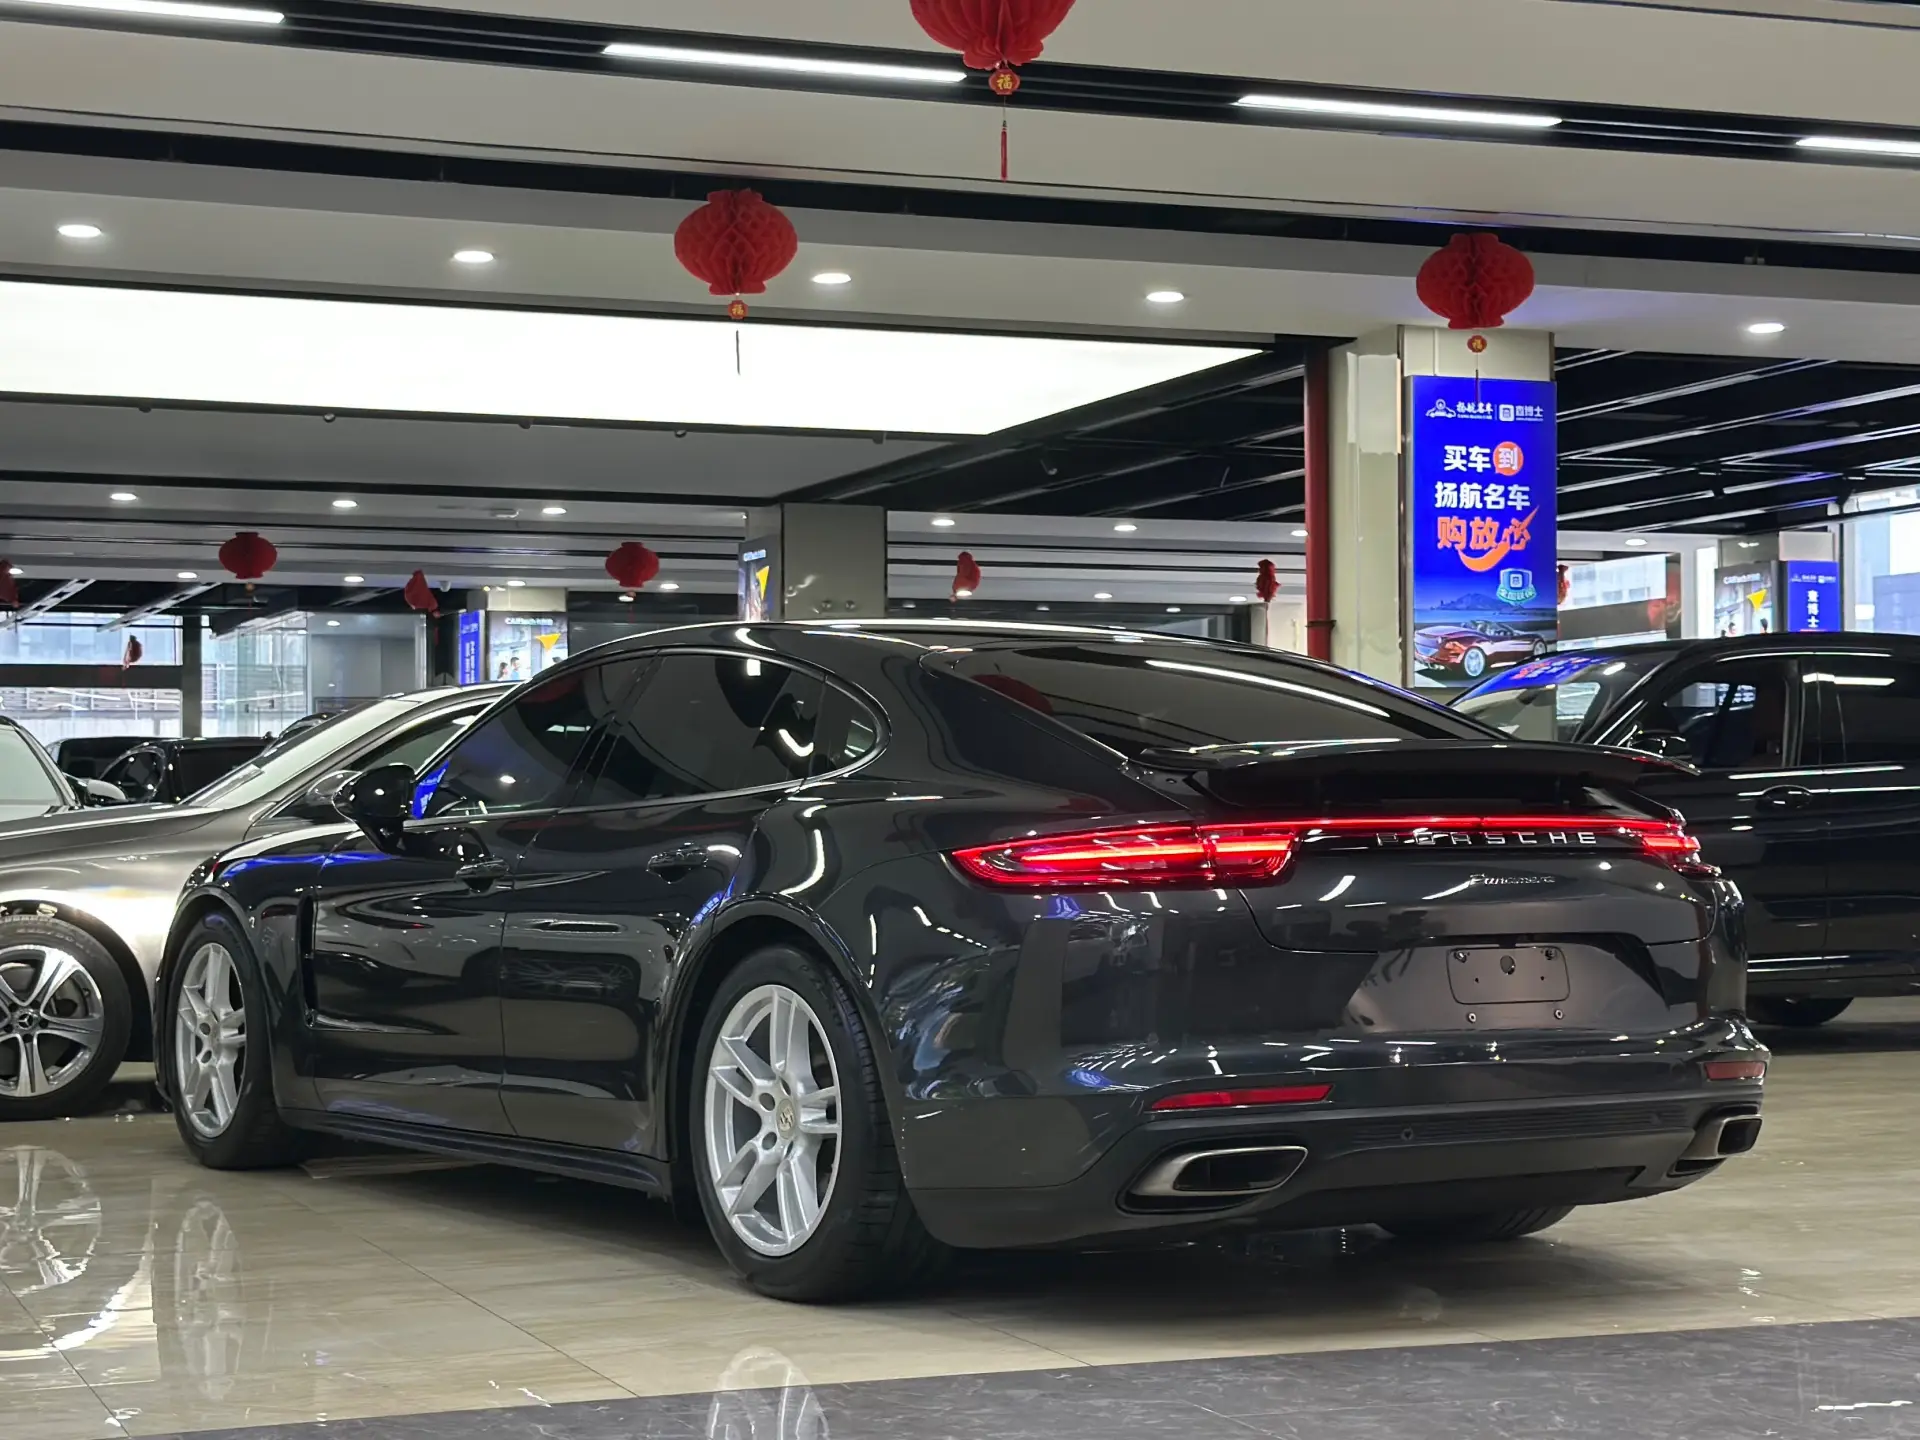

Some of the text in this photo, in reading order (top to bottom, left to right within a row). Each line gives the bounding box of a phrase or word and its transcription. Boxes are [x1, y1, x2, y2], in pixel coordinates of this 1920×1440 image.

[996, 73, 1013, 90] 福
[1443, 445, 1519, 473] 买车到
[1434, 480, 1531, 511] 扬航名车
[1437, 511, 1535, 556] 购放心
